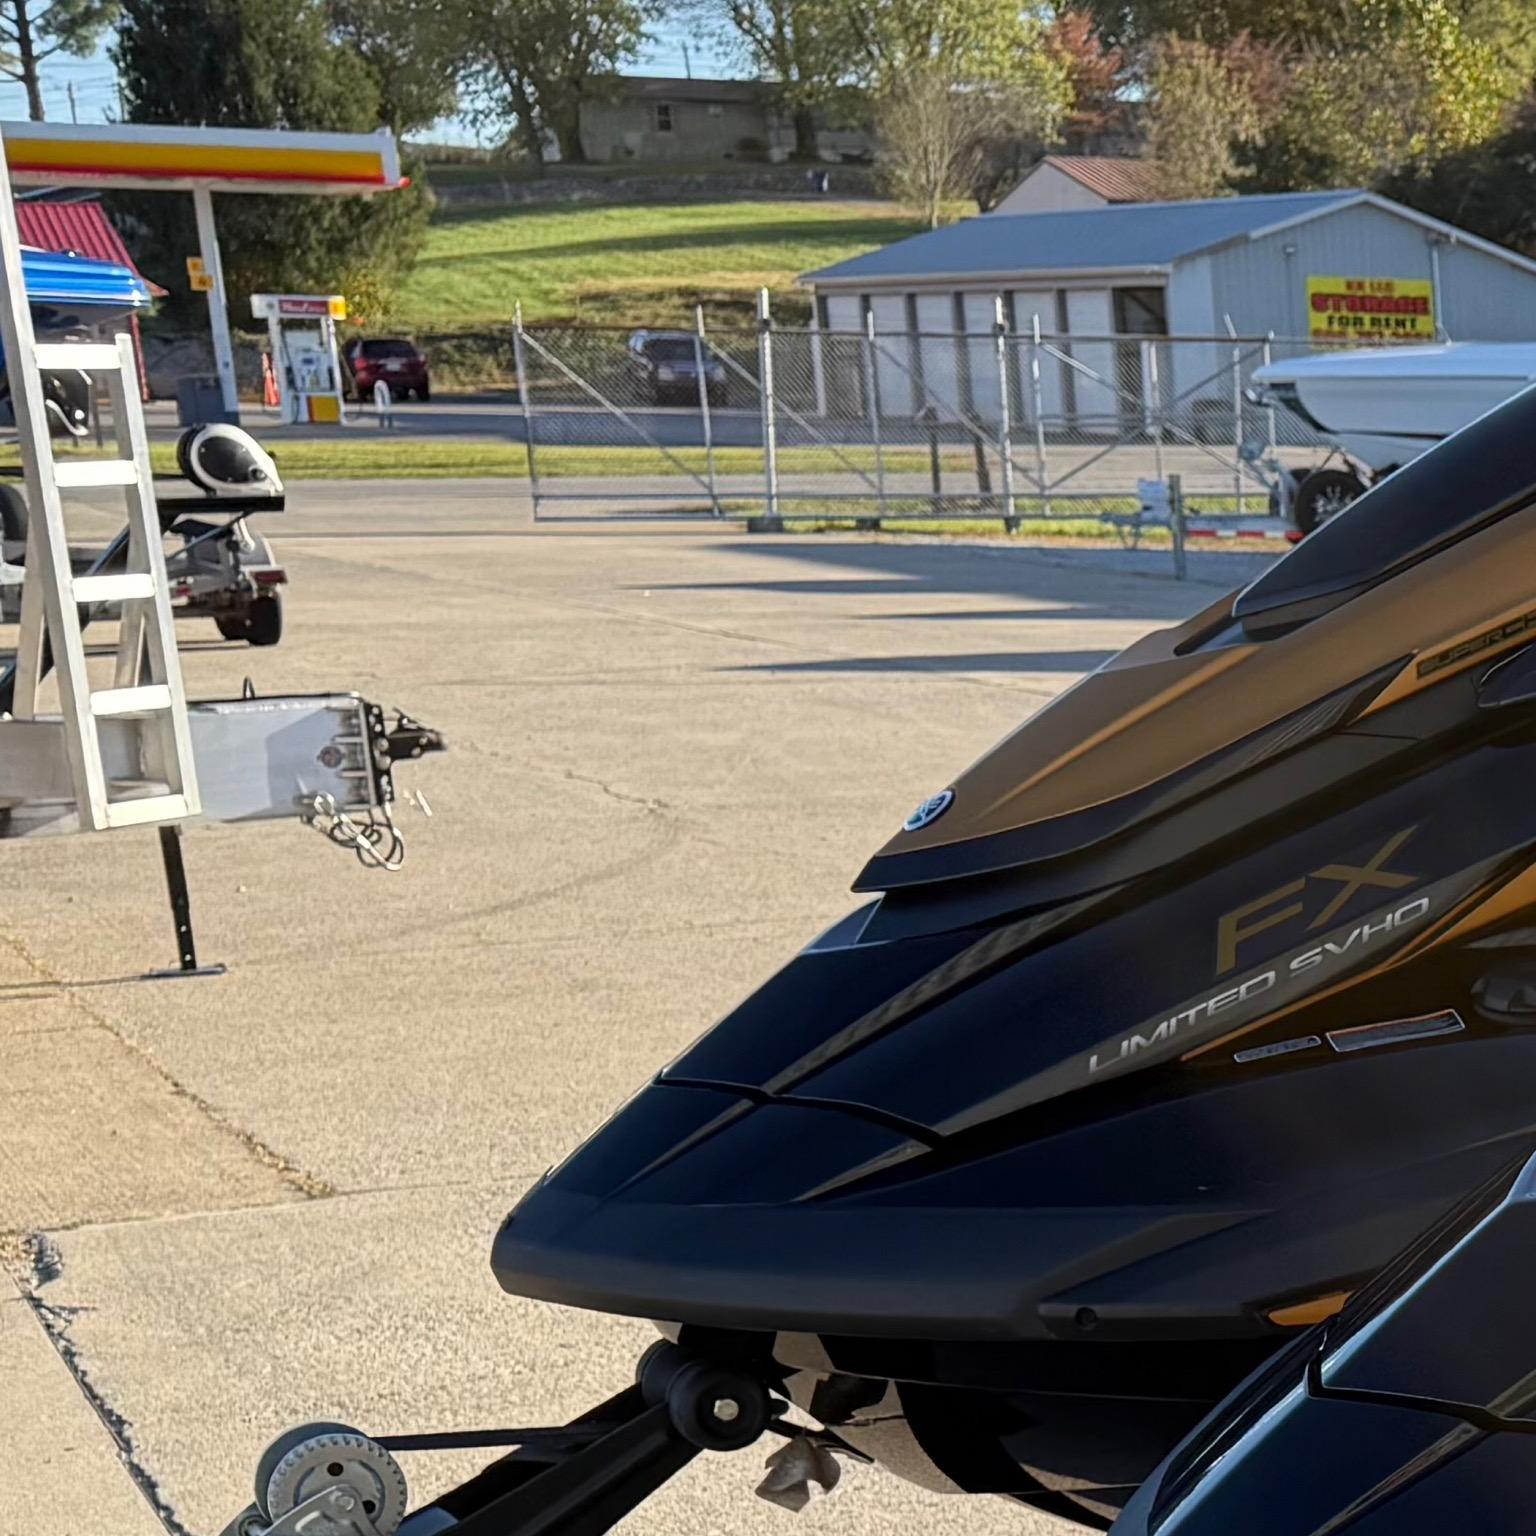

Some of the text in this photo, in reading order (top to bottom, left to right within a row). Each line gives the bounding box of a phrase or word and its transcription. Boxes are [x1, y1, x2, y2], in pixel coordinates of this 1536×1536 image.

[1311, 293, 1429, 315] STORAGE
[1327, 315, 1417, 330] FOR RENT
[1216, 824, 1420, 976] FX
[1089, 970, 1276, 1074] LIMITED
[1289, 896, 1430, 977] SVHO
